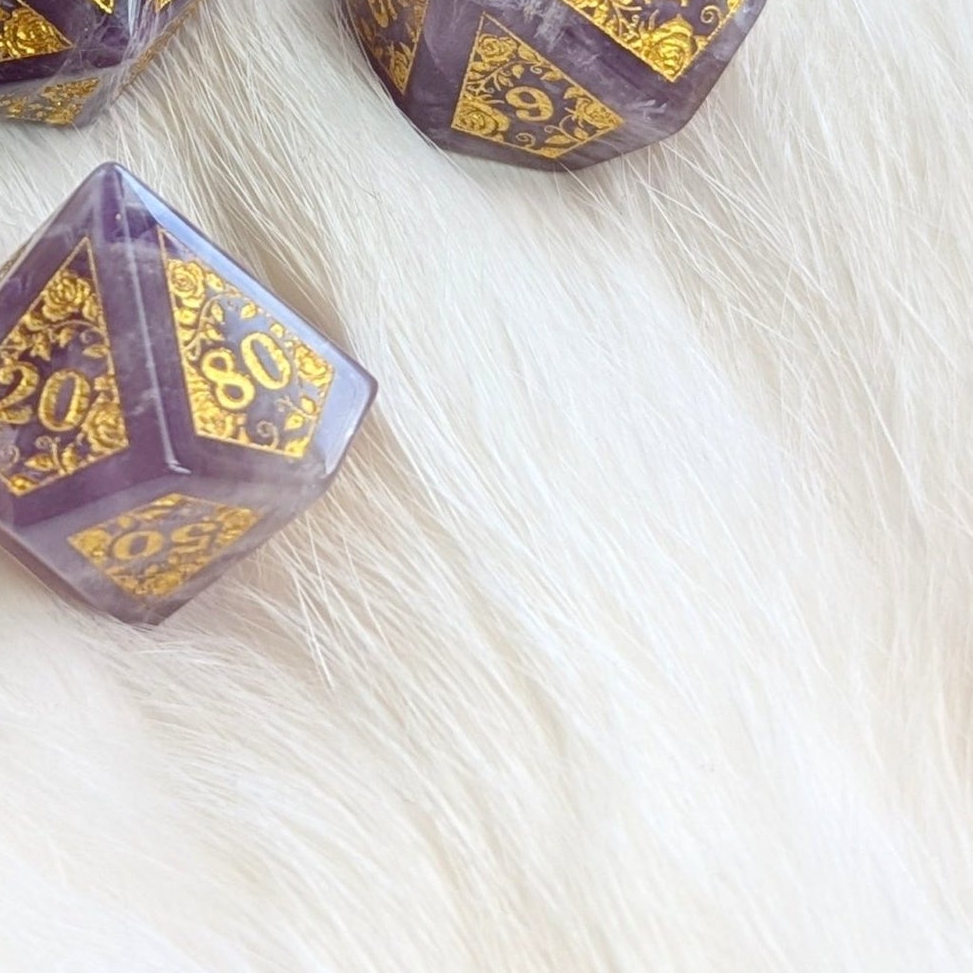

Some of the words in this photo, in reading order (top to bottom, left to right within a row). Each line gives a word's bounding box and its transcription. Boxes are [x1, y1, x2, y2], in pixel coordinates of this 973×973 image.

[505, 86, 554, 122] 9
[199, 332, 292, 411] 80
[113, 522, 218, 561] 50
